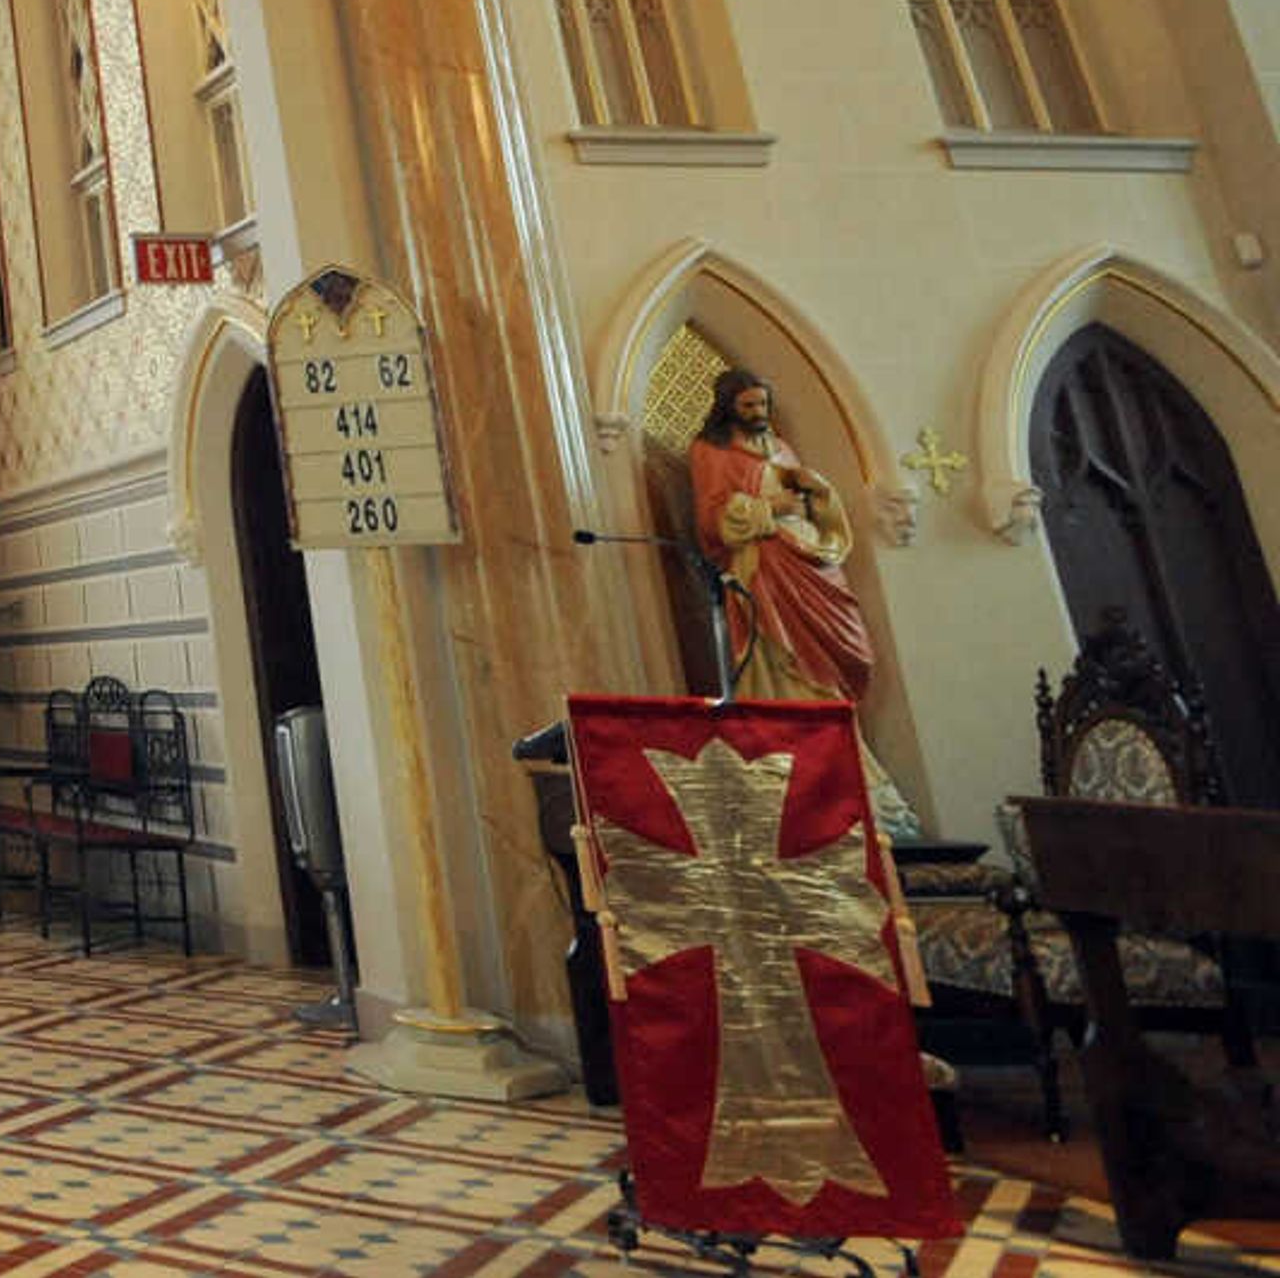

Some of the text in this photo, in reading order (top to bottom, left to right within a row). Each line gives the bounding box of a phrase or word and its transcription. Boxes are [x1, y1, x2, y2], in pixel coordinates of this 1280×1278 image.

[146, 243, 201, 279] EXIT
[305, 355, 410, 393] 82 62
[336, 405, 378, 438] 414
[342, 450, 387, 485] 401
[348, 498, 398, 533] 260
